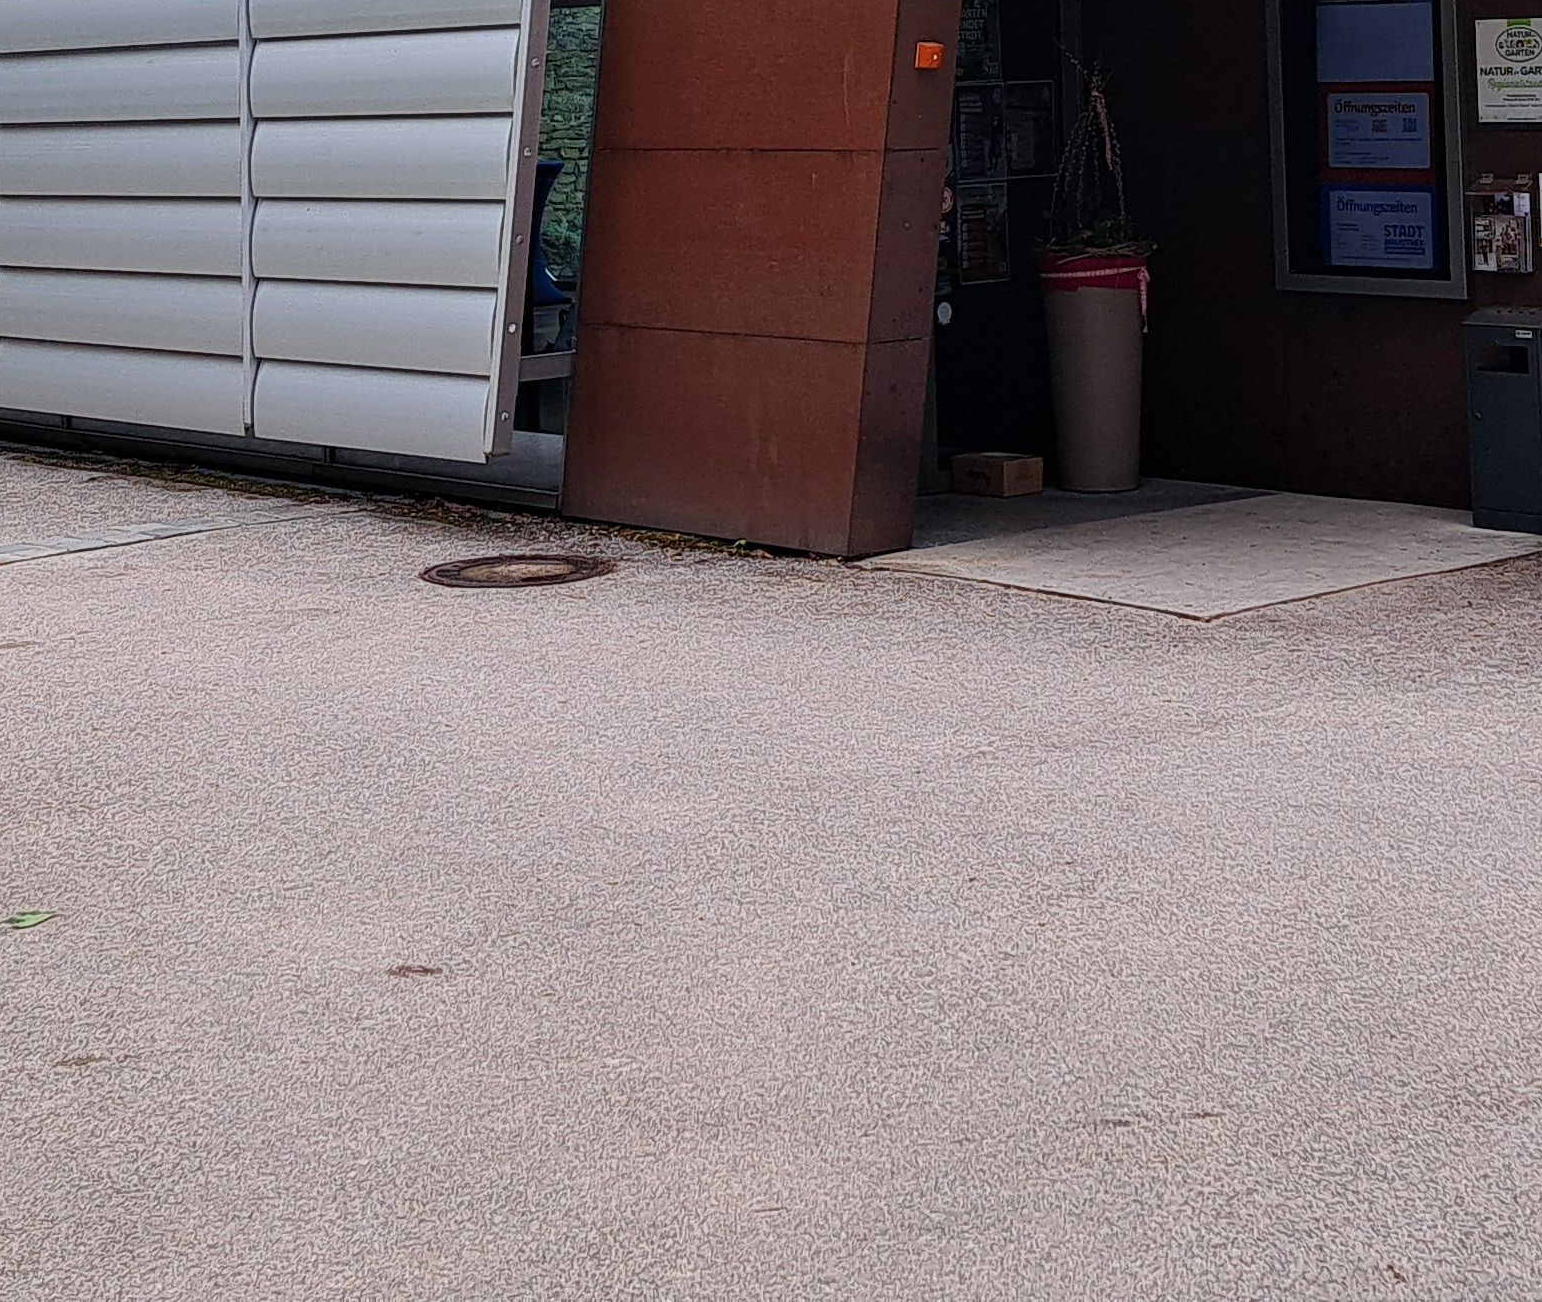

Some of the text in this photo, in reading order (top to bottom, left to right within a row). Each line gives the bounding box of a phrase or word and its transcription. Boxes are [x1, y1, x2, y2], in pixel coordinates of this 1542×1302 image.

[1504, 49, 1535, 57] GARTEN
[1480, 66, 1513, 76] NATUR
[1334, 99, 1416, 116] Öffnungszeiten
[1336, 196, 1418, 216] Öffnungszeiten
[1383, 224, 1425, 238] STADT
